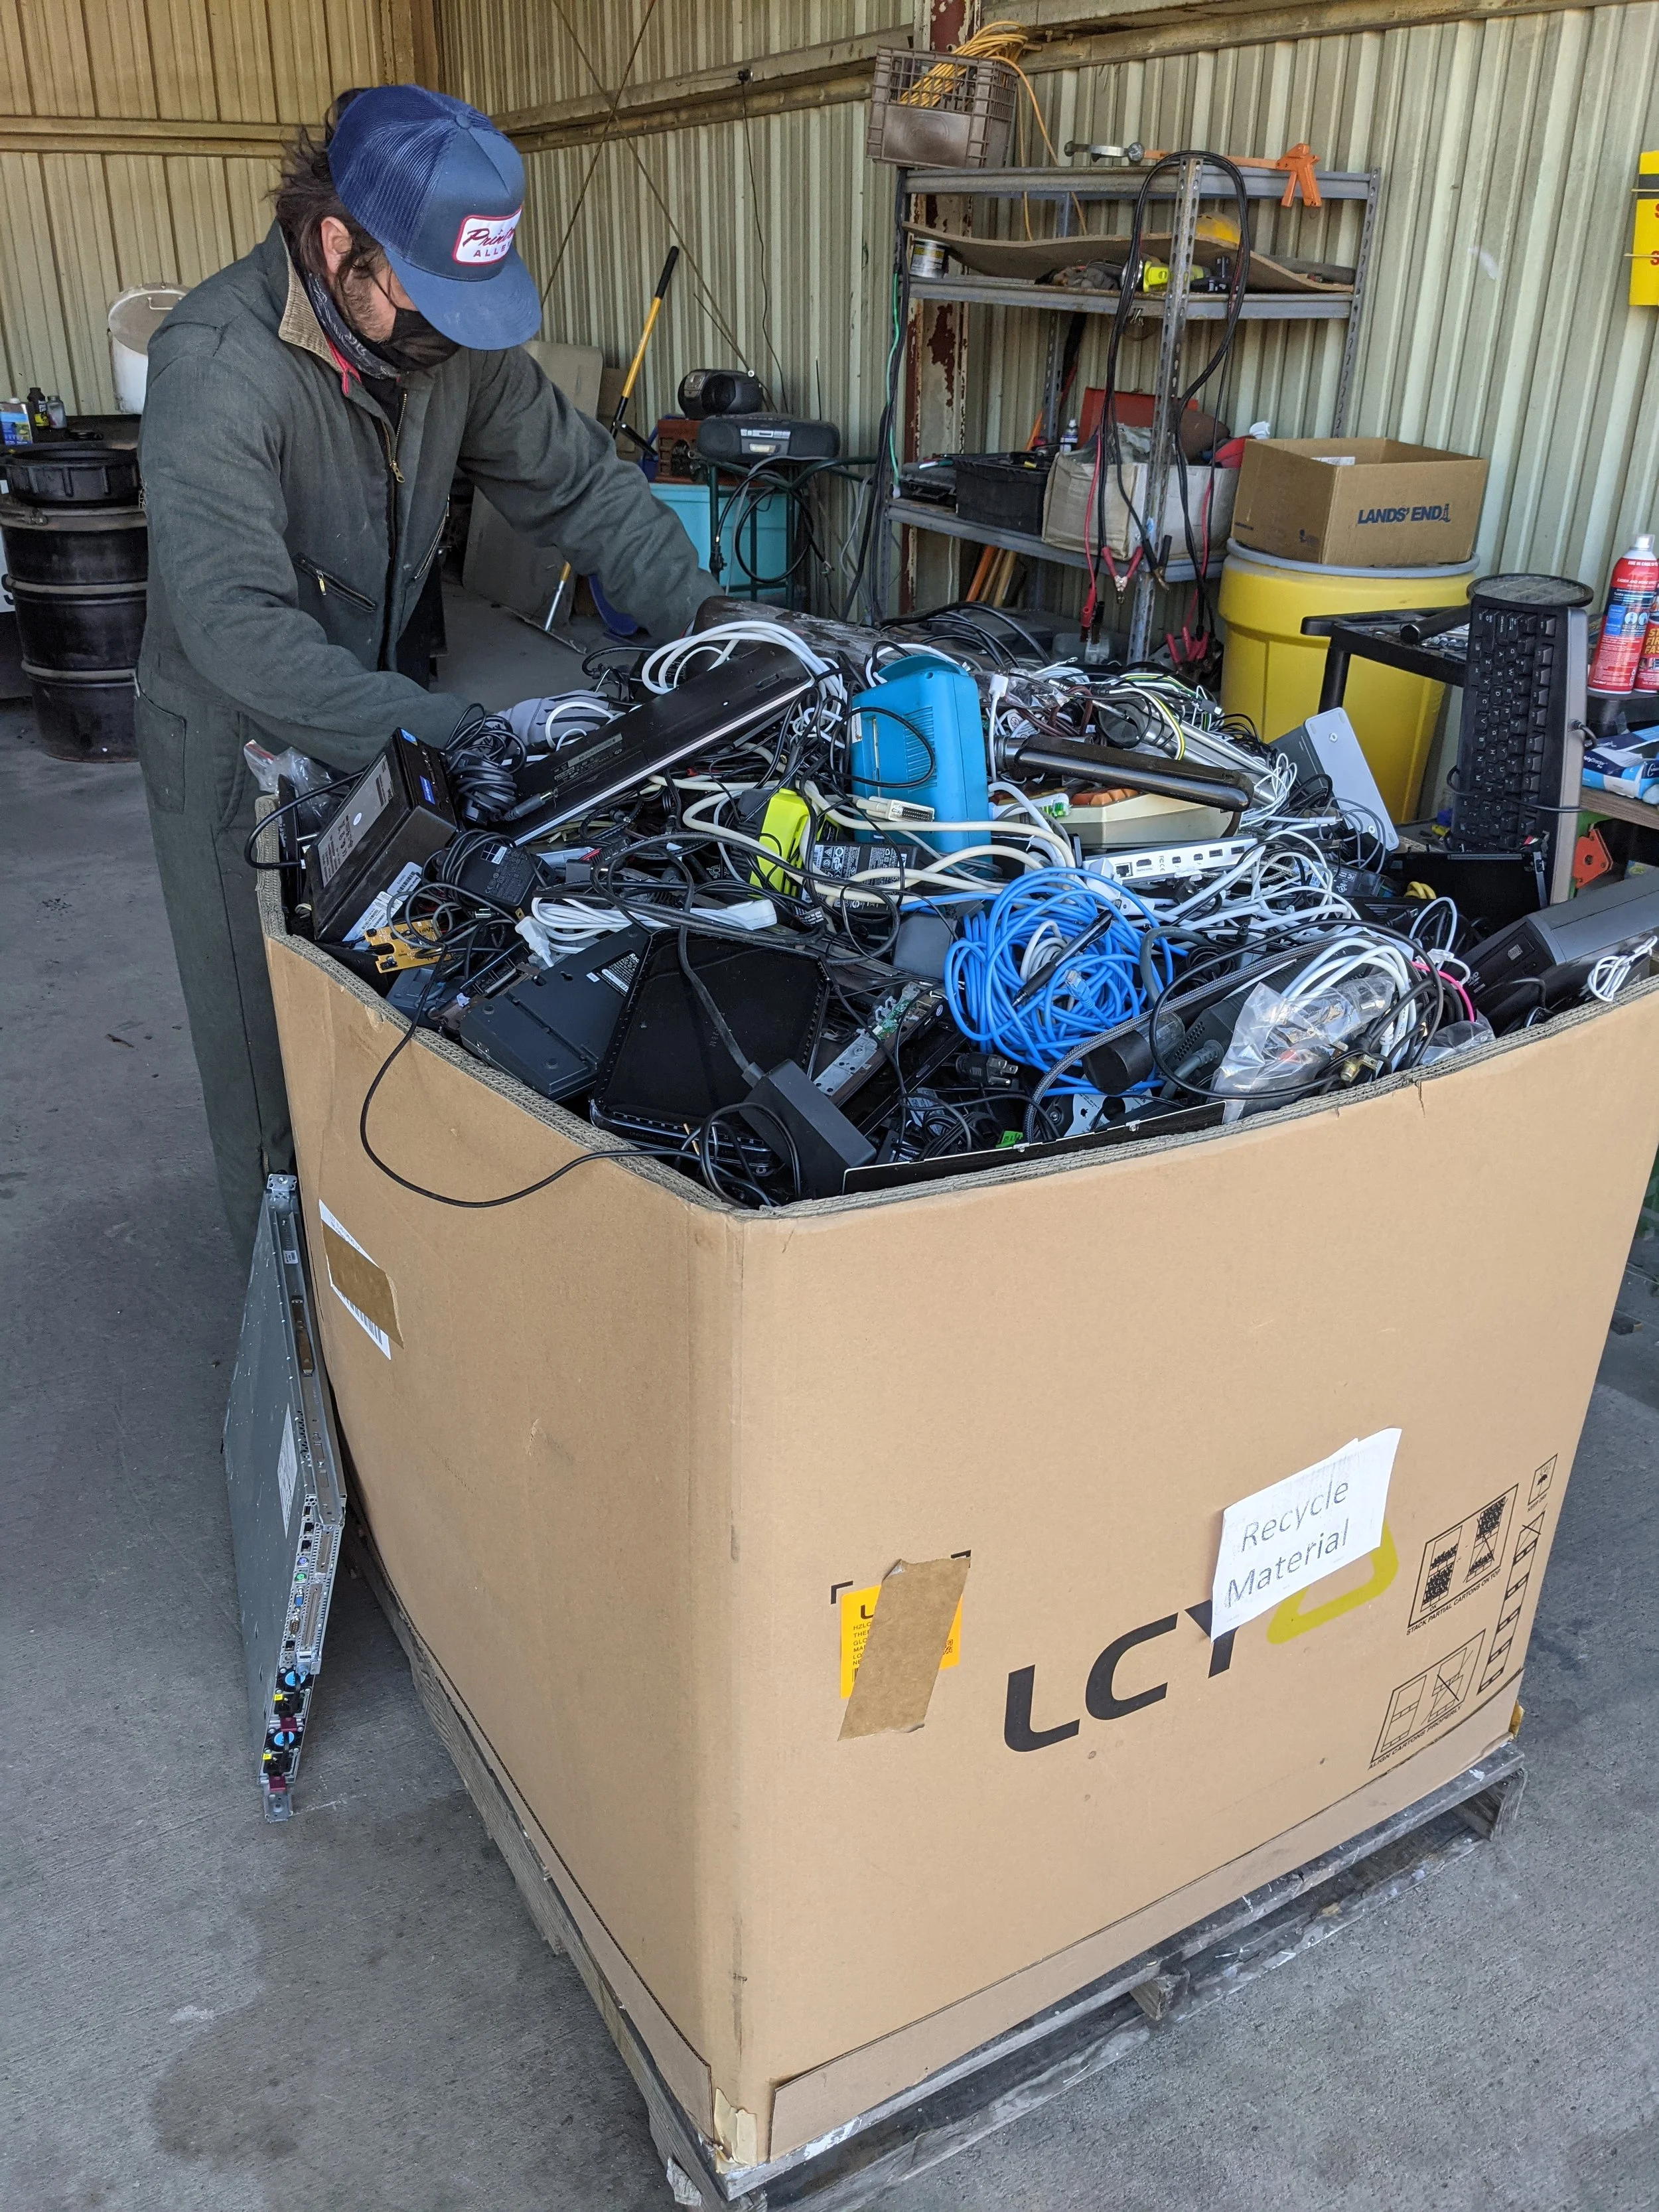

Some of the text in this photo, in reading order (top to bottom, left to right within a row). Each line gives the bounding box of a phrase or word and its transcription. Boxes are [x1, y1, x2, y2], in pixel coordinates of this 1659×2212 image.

[1358, 506, 1442, 524] LANDS' END
[1242, 1479, 1348, 1552] Recycle
[1225, 1518, 1349, 1607] Material
[1406, 1568, 1502, 1635] STACK PARTIAL CARTONS ON TOP
[1368, 1704, 1463, 1771] ALIGN CARTONS PROPERLY
